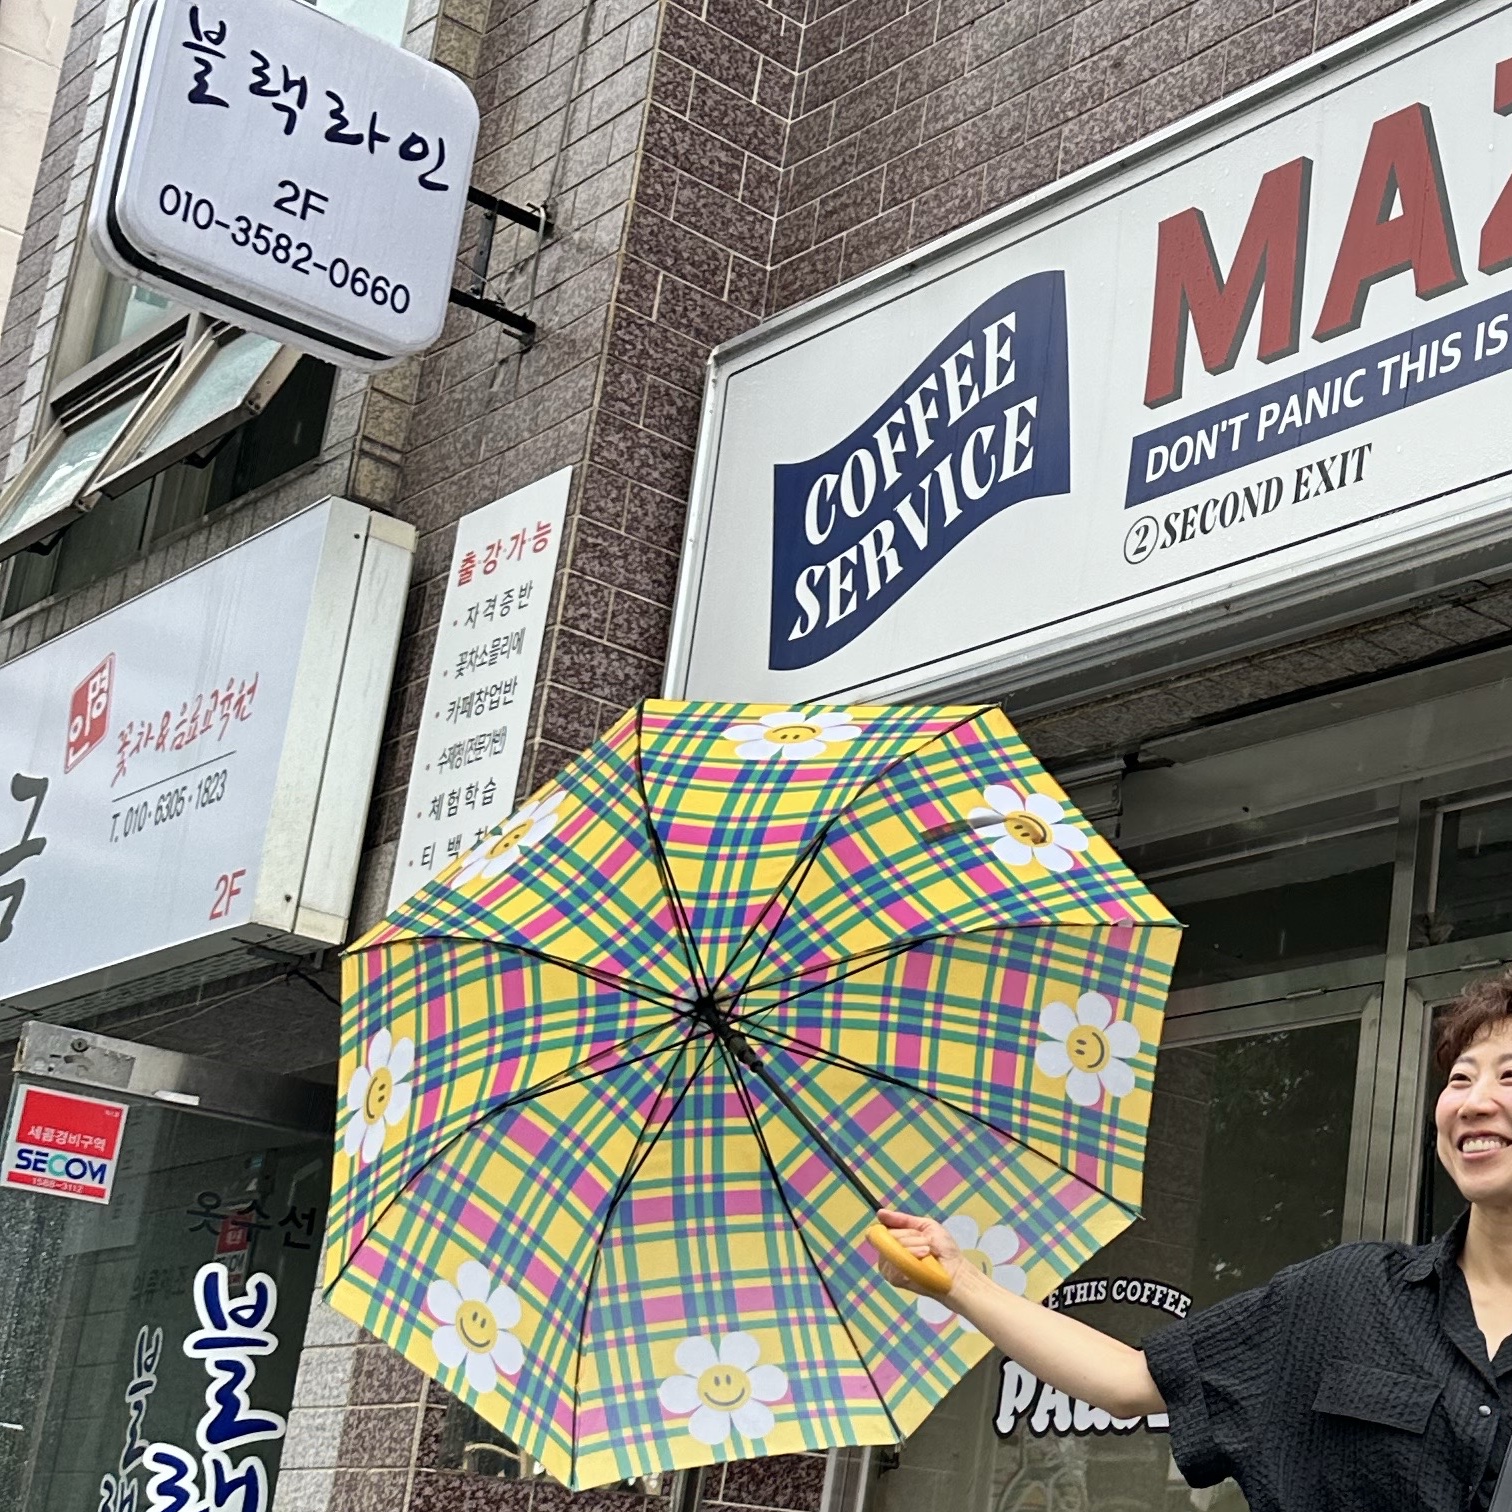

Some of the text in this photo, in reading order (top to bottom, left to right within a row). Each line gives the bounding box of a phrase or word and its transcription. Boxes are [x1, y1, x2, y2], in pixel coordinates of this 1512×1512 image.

[182, 5, 450, 192] 블랙라인
[273, 179, 329, 221] 2F
[158, 183, 411, 315] 010-3582-0660
[804, 311, 1018, 547] COFFEE
[1144, 413, 1250, 485] DON'T
[1256, 367, 1366, 443] PANIC
[1376, 333, 1463, 397] THIS
[1473, 319, 1509, 359] IS
[787, 396, 1040, 642] SERVICE
[1291, 443, 1373, 504] EXIT
[208, 868, 247, 921] 2F
[15, 1147, 107, 1184] SECOM
[1062, 1279, 1108, 1306] THIS
[1112, 1279, 1192, 1319] COFFEE
